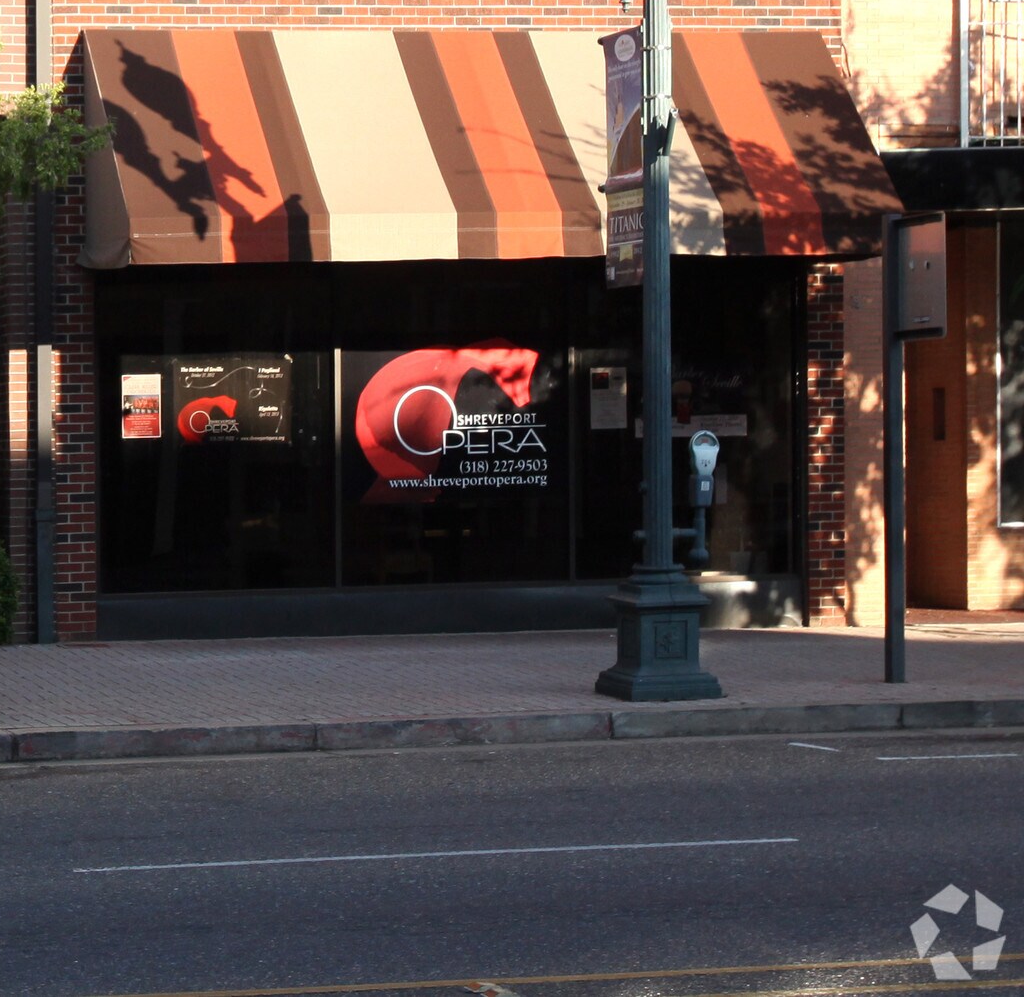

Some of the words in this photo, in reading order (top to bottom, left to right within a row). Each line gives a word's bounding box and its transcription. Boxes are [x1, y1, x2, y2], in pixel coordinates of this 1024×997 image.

[394, 385, 547, 456] OPERA
[457, 413, 537, 426] SHREVEPORT
[459, 460, 489, 474] (318)
[493, 459, 548, 473] 227-9503
[389, 474, 548, 489] www.shreveportopera.org
